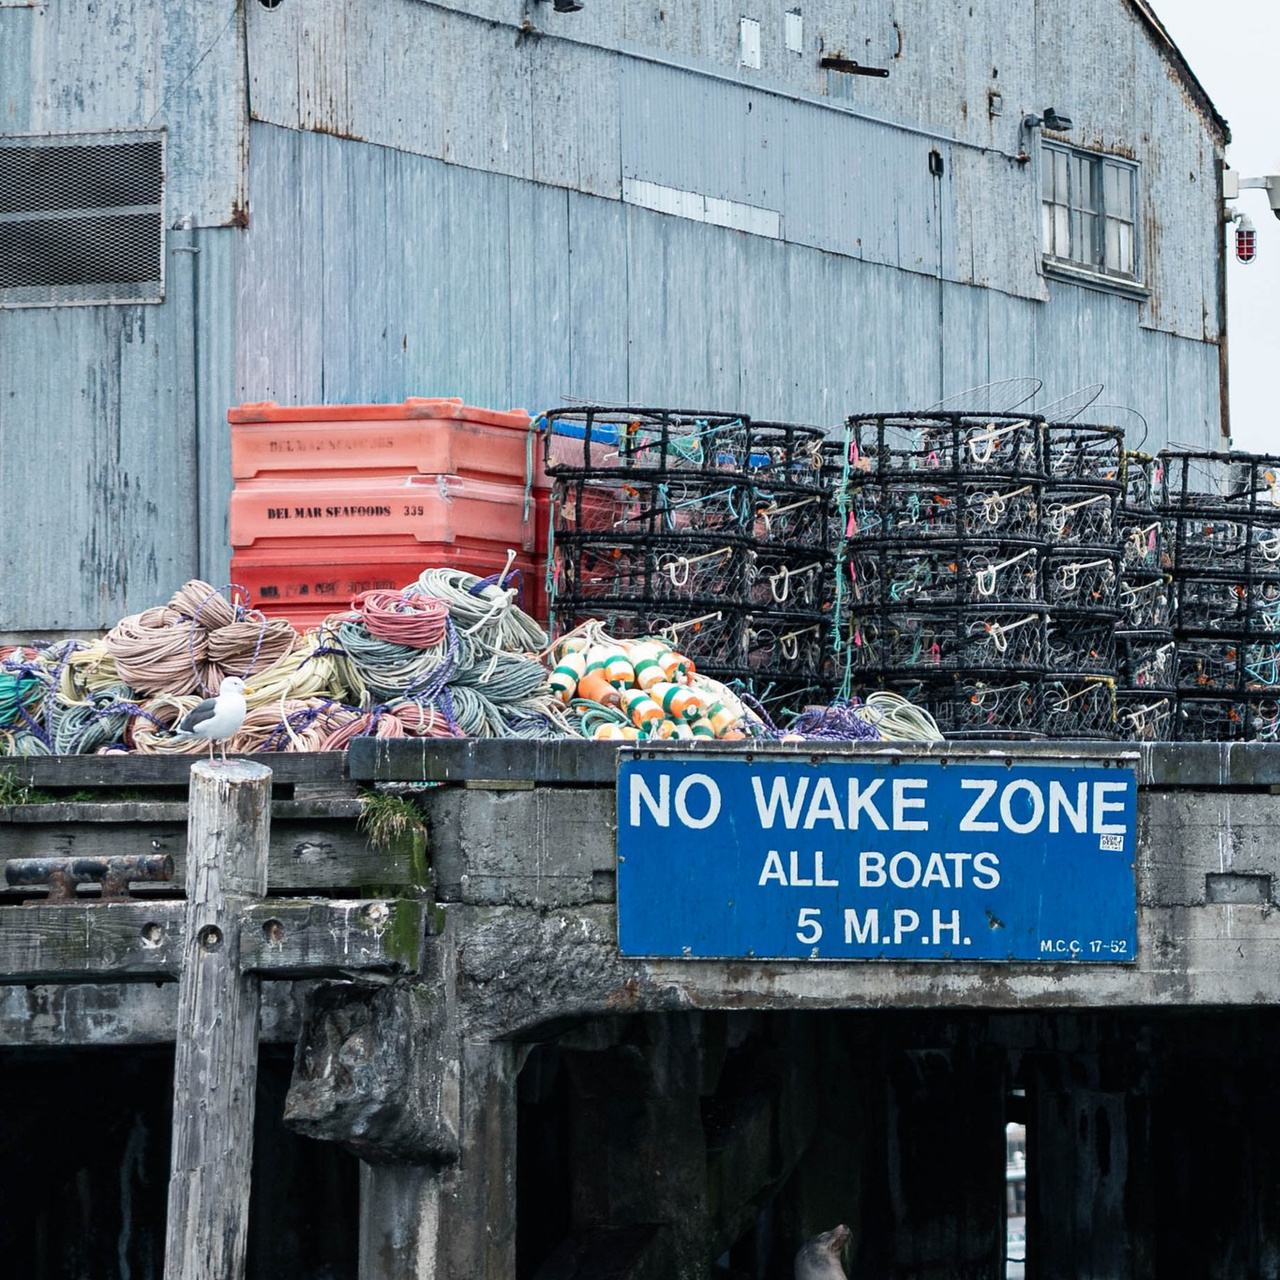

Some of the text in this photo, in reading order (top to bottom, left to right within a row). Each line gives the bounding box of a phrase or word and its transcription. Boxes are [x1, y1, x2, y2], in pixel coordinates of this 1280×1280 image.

[267, 507, 292, 519] DEL
[295, 507, 323, 519] MAR
[325, 505, 391, 518] SEAFOODS
[629, 773, 1128, 834] NO WAKE ZONE
[758, 850, 1001, 890] ALL BOATS
[796, 908, 972, 945] 5 M.P.H.
[1040, 939, 1128, 953] M.C.C. 17-52
